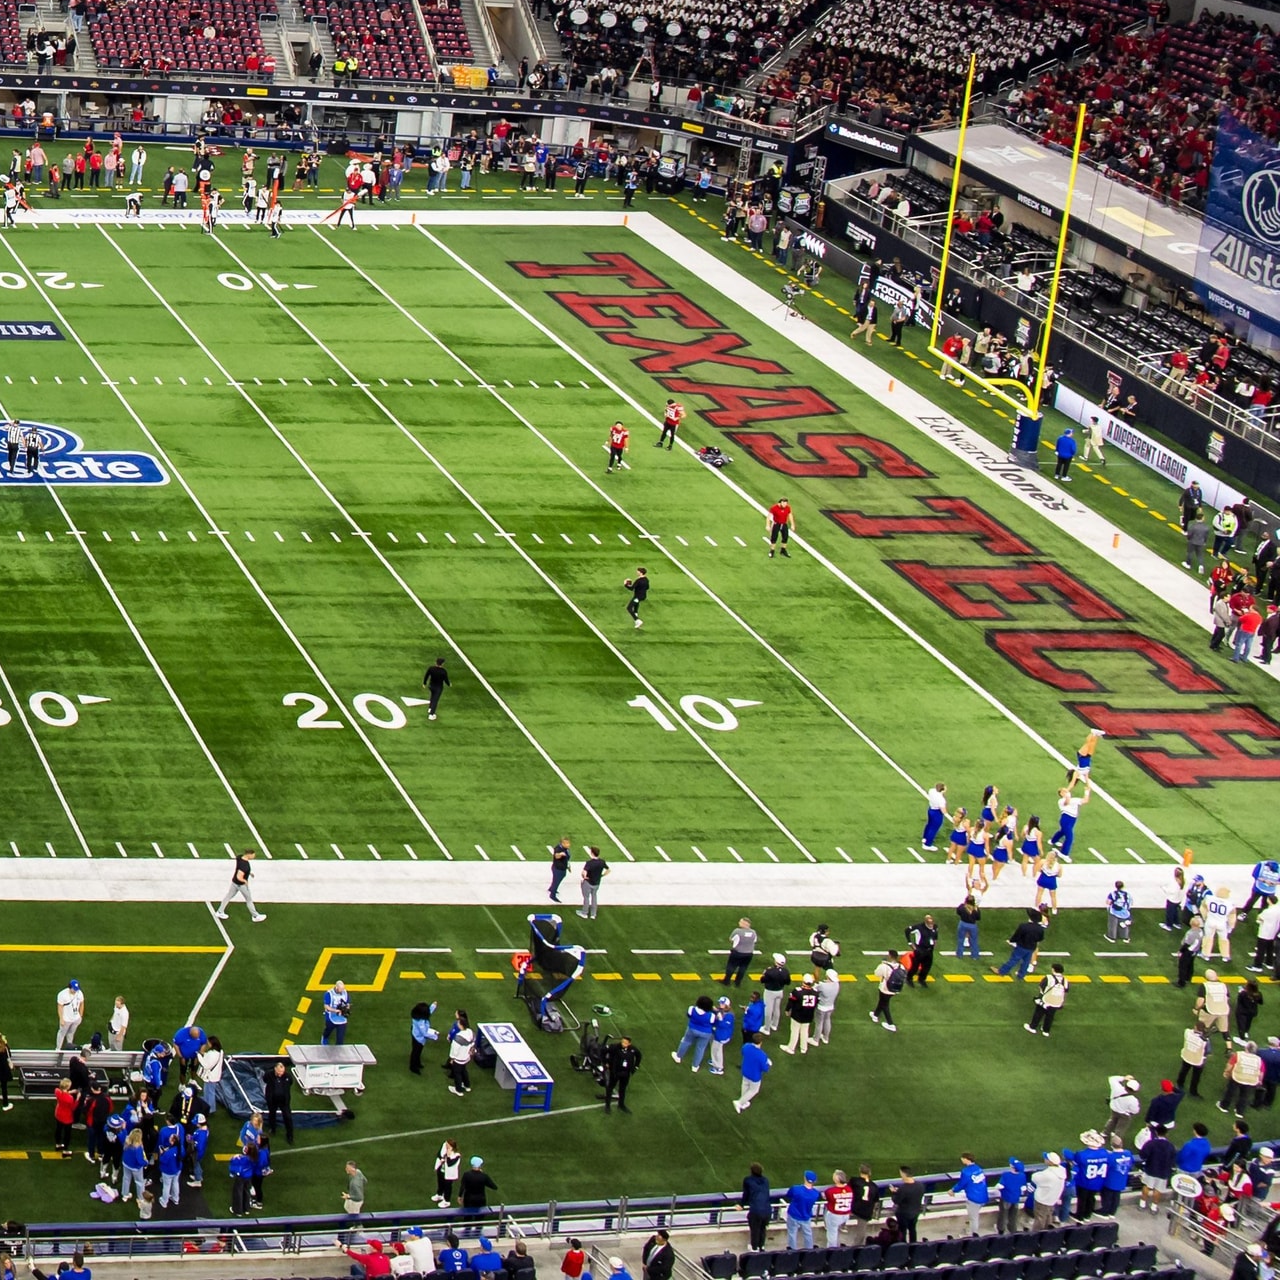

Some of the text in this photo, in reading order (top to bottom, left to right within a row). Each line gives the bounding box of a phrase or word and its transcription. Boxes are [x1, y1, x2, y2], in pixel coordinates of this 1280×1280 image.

[839, 126, 898, 153] Blockchain.com
[1018, 193, 1040, 211] WRECK
[846, 222, 877, 250] ESPN
[1210, 234, 1280, 289] Allsta
[1208, 290, 1234, 312] WRECK
[1107, 420, 1188, 484] A DIFFERENT LEAGUE
[510, 251, 1280, 788] TEXAS TECH
[283, 692, 408, 730] 20
[628, 694, 740, 732] 10
[1209, 902, 1227, 915] 00
[803, 995, 815, 1006] 23
[1086, 1163, 1108, 1179] 84
